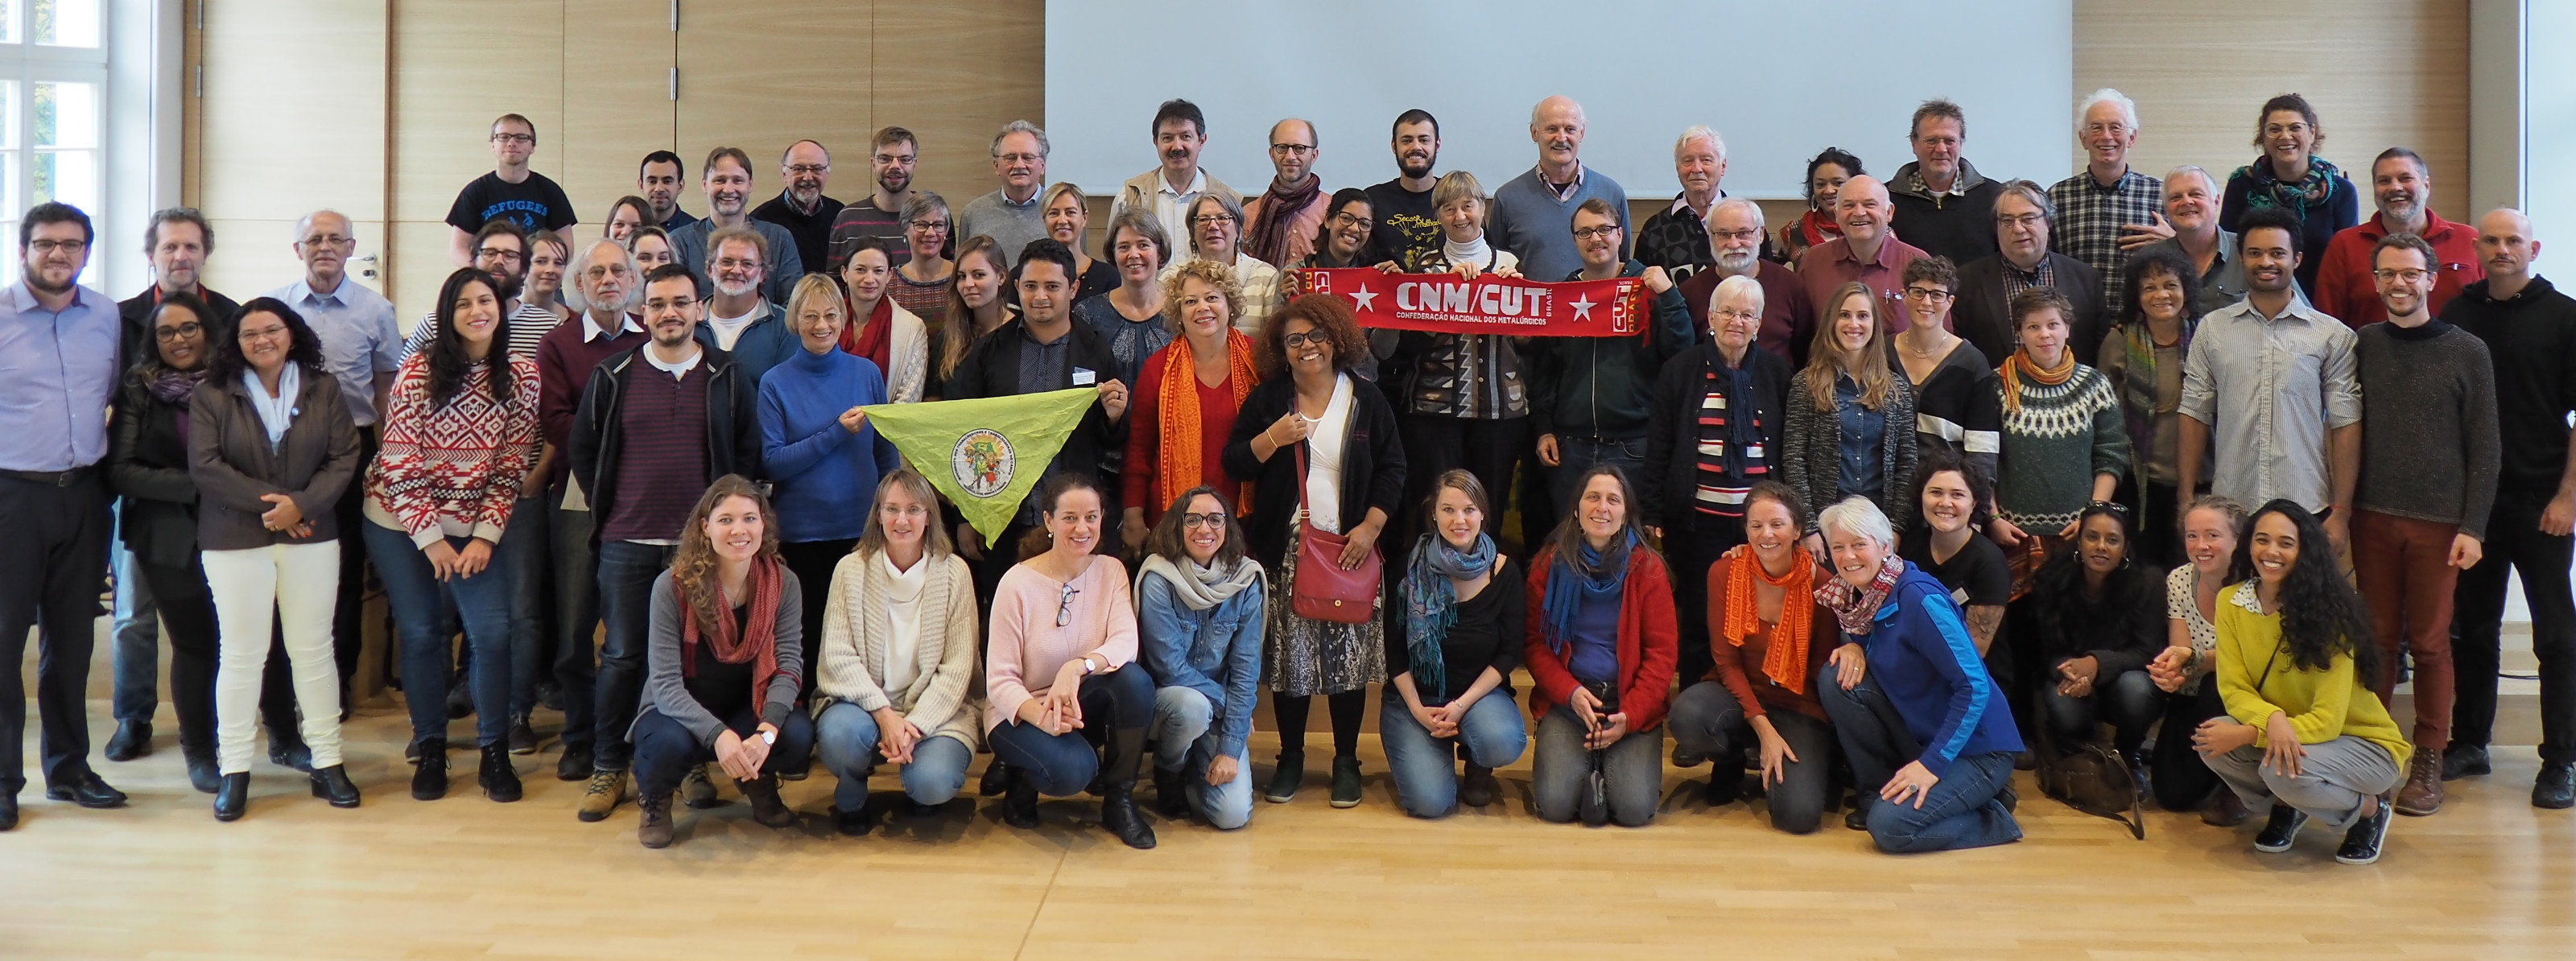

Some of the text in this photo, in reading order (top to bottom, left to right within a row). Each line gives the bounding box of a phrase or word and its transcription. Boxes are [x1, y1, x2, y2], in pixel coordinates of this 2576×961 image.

[481, 200, 547, 221] REFUGEES
[1315, 272, 1329, 294] CU
[1397, 283, 1546, 316] CNM/CUT
[1613, 286, 1631, 332] CUT
[1396, 311, 1546, 325] CONFEDERAÇÃO NACIONAL DOS METALÚRGICOS
